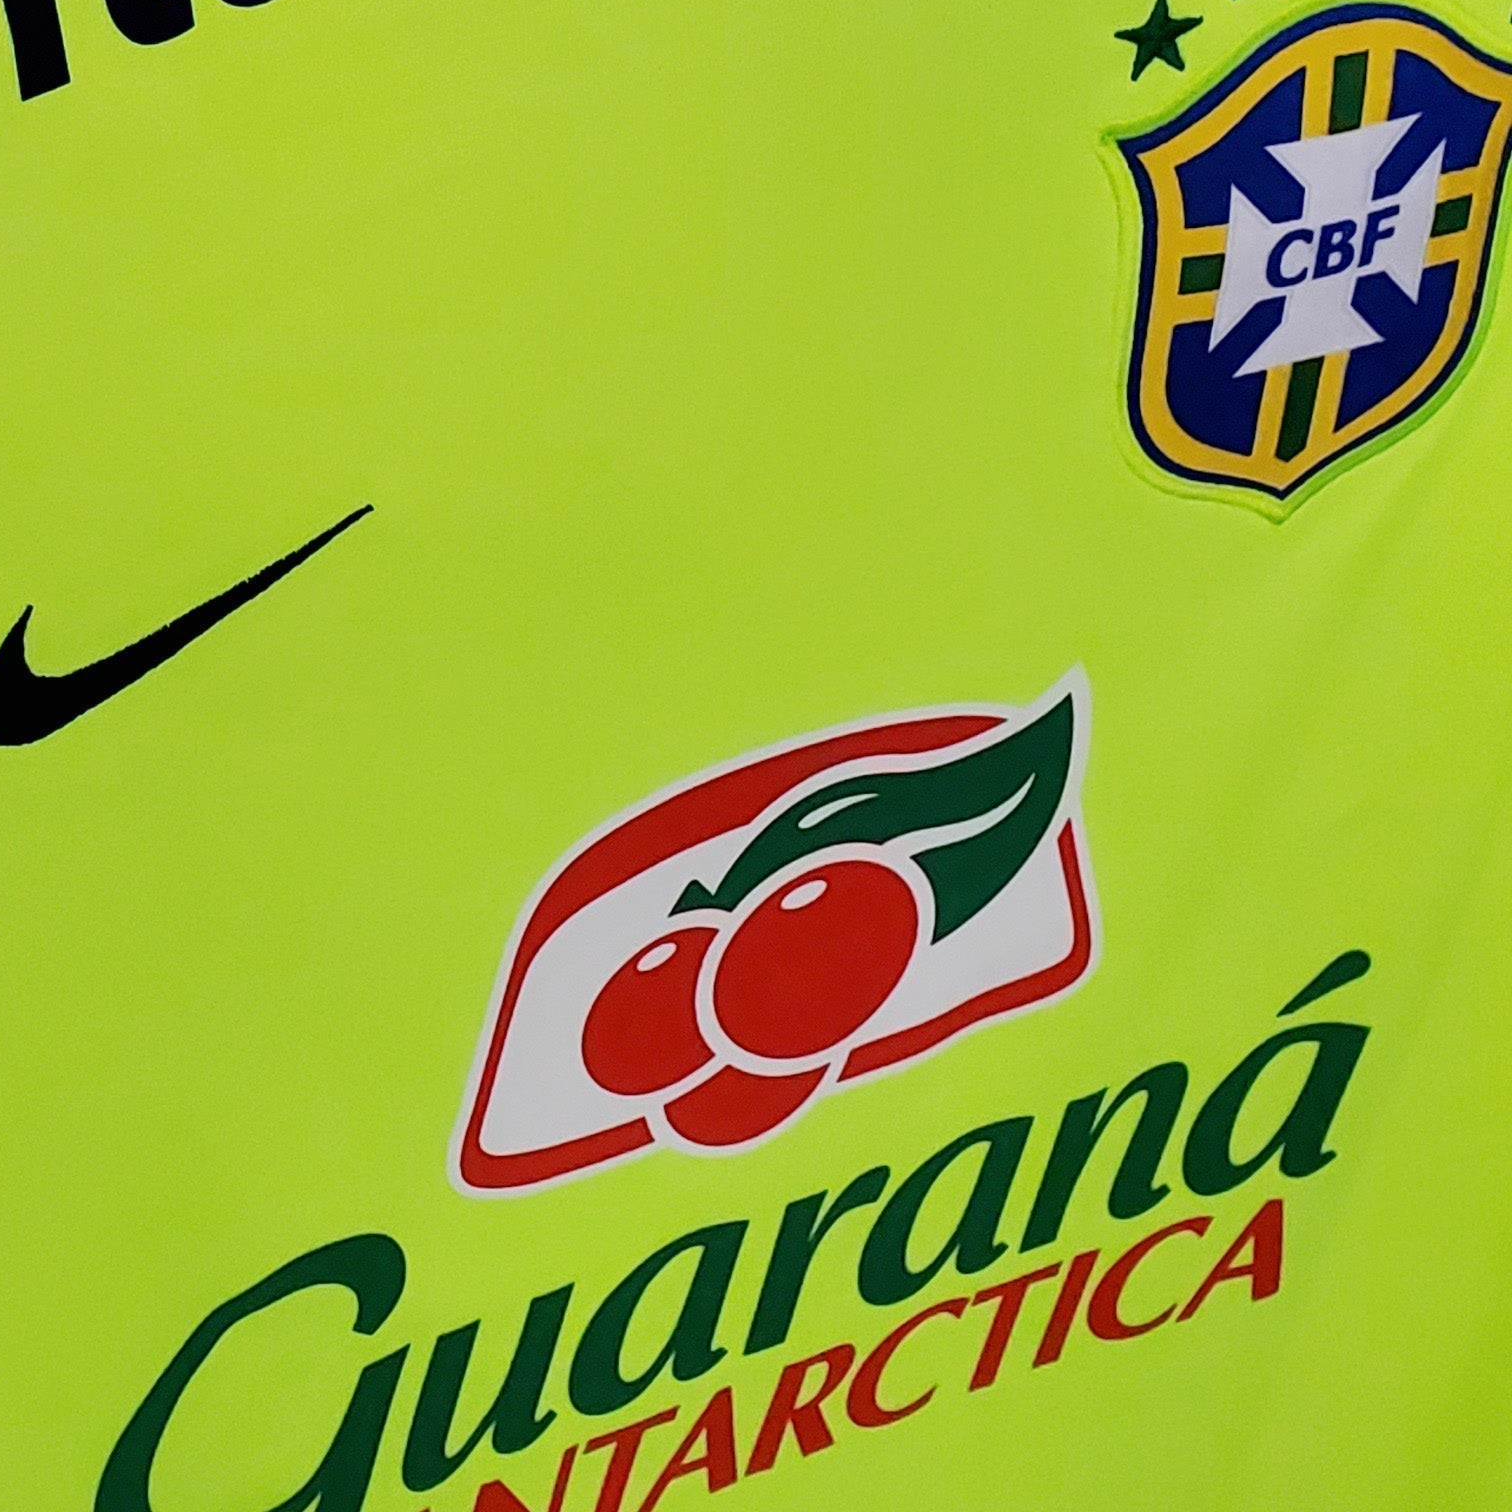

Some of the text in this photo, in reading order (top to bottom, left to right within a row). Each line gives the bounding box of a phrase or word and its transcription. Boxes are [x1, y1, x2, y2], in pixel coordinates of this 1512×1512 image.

[1265, 204, 1400, 290] CBF
[93, 949, 1373, 1512] Guaraná
[412, 1199, 1285, 1512] NTARCTICA
